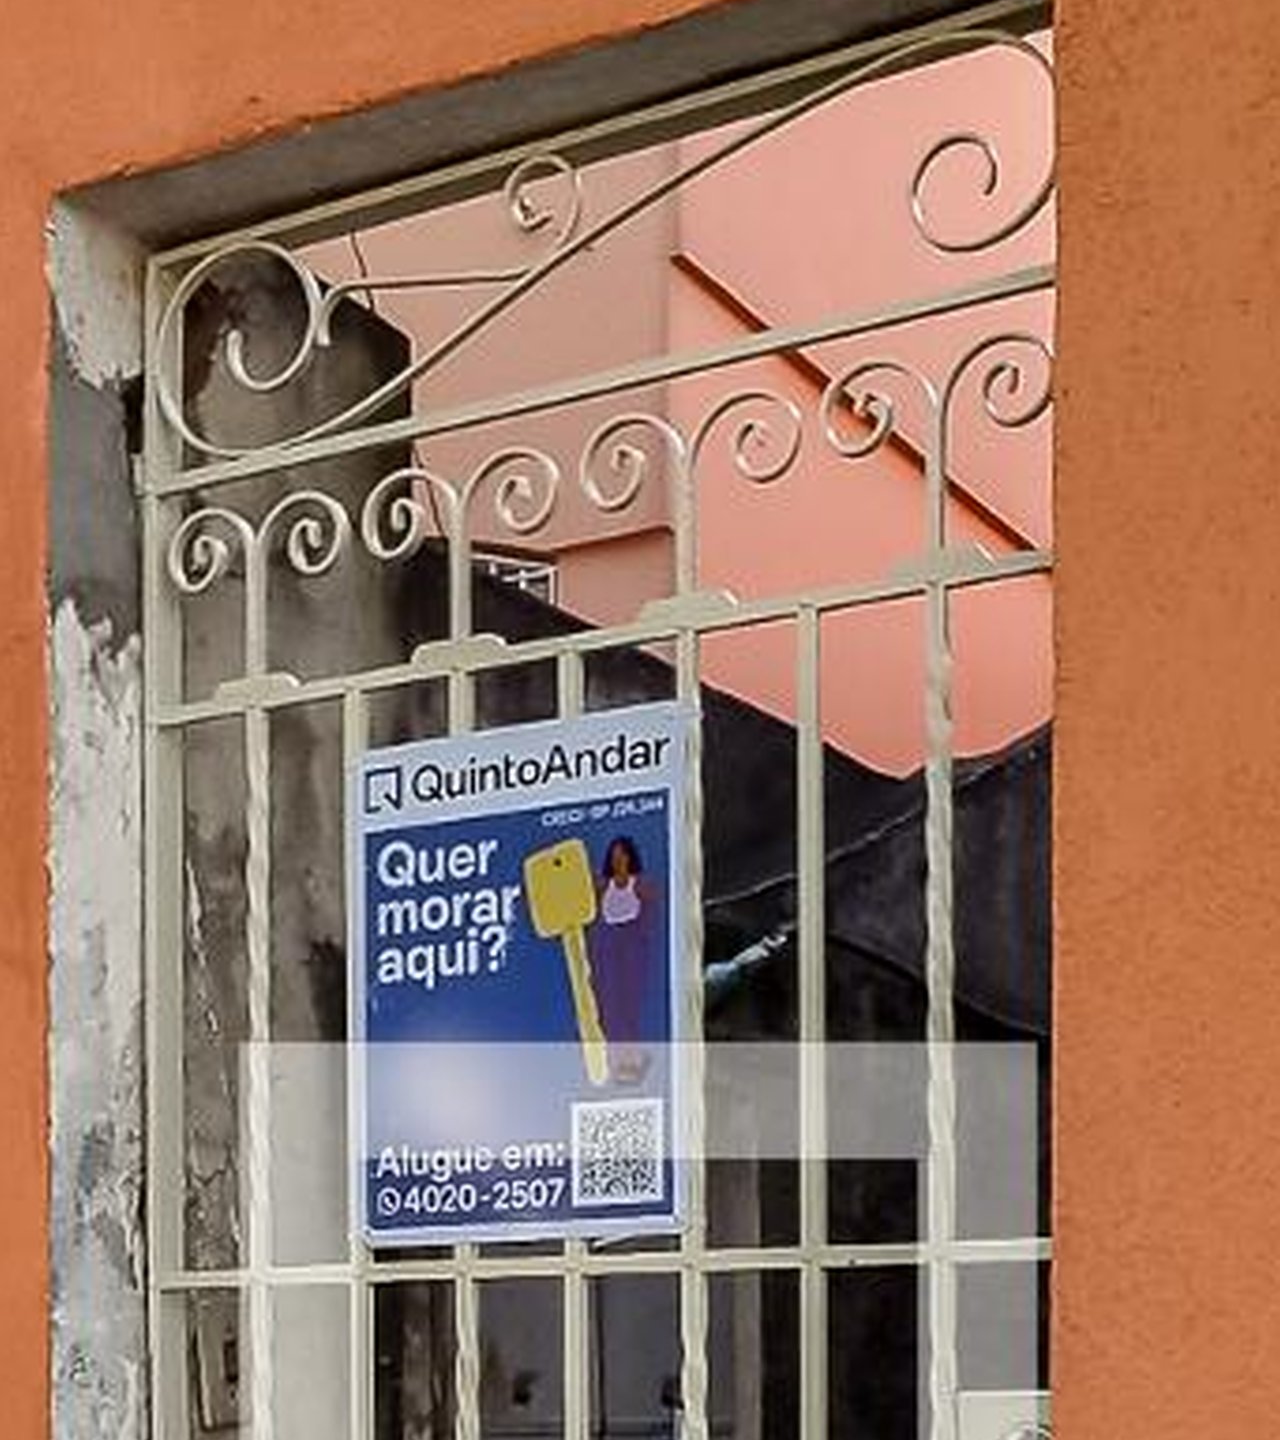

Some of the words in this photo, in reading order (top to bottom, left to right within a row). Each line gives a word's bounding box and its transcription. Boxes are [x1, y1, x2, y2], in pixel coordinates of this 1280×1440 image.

[411, 733, 671, 803] QuintoAndar
[377, 840, 498, 887] Quer
[378, 884, 520, 935] morar
[377, 924, 507, 990] aqui?
[376, 1144, 494, 1183] Alugue
[502, 1141, 566, 1171] em:
[403, 1176, 566, 1213] 4020-2507
